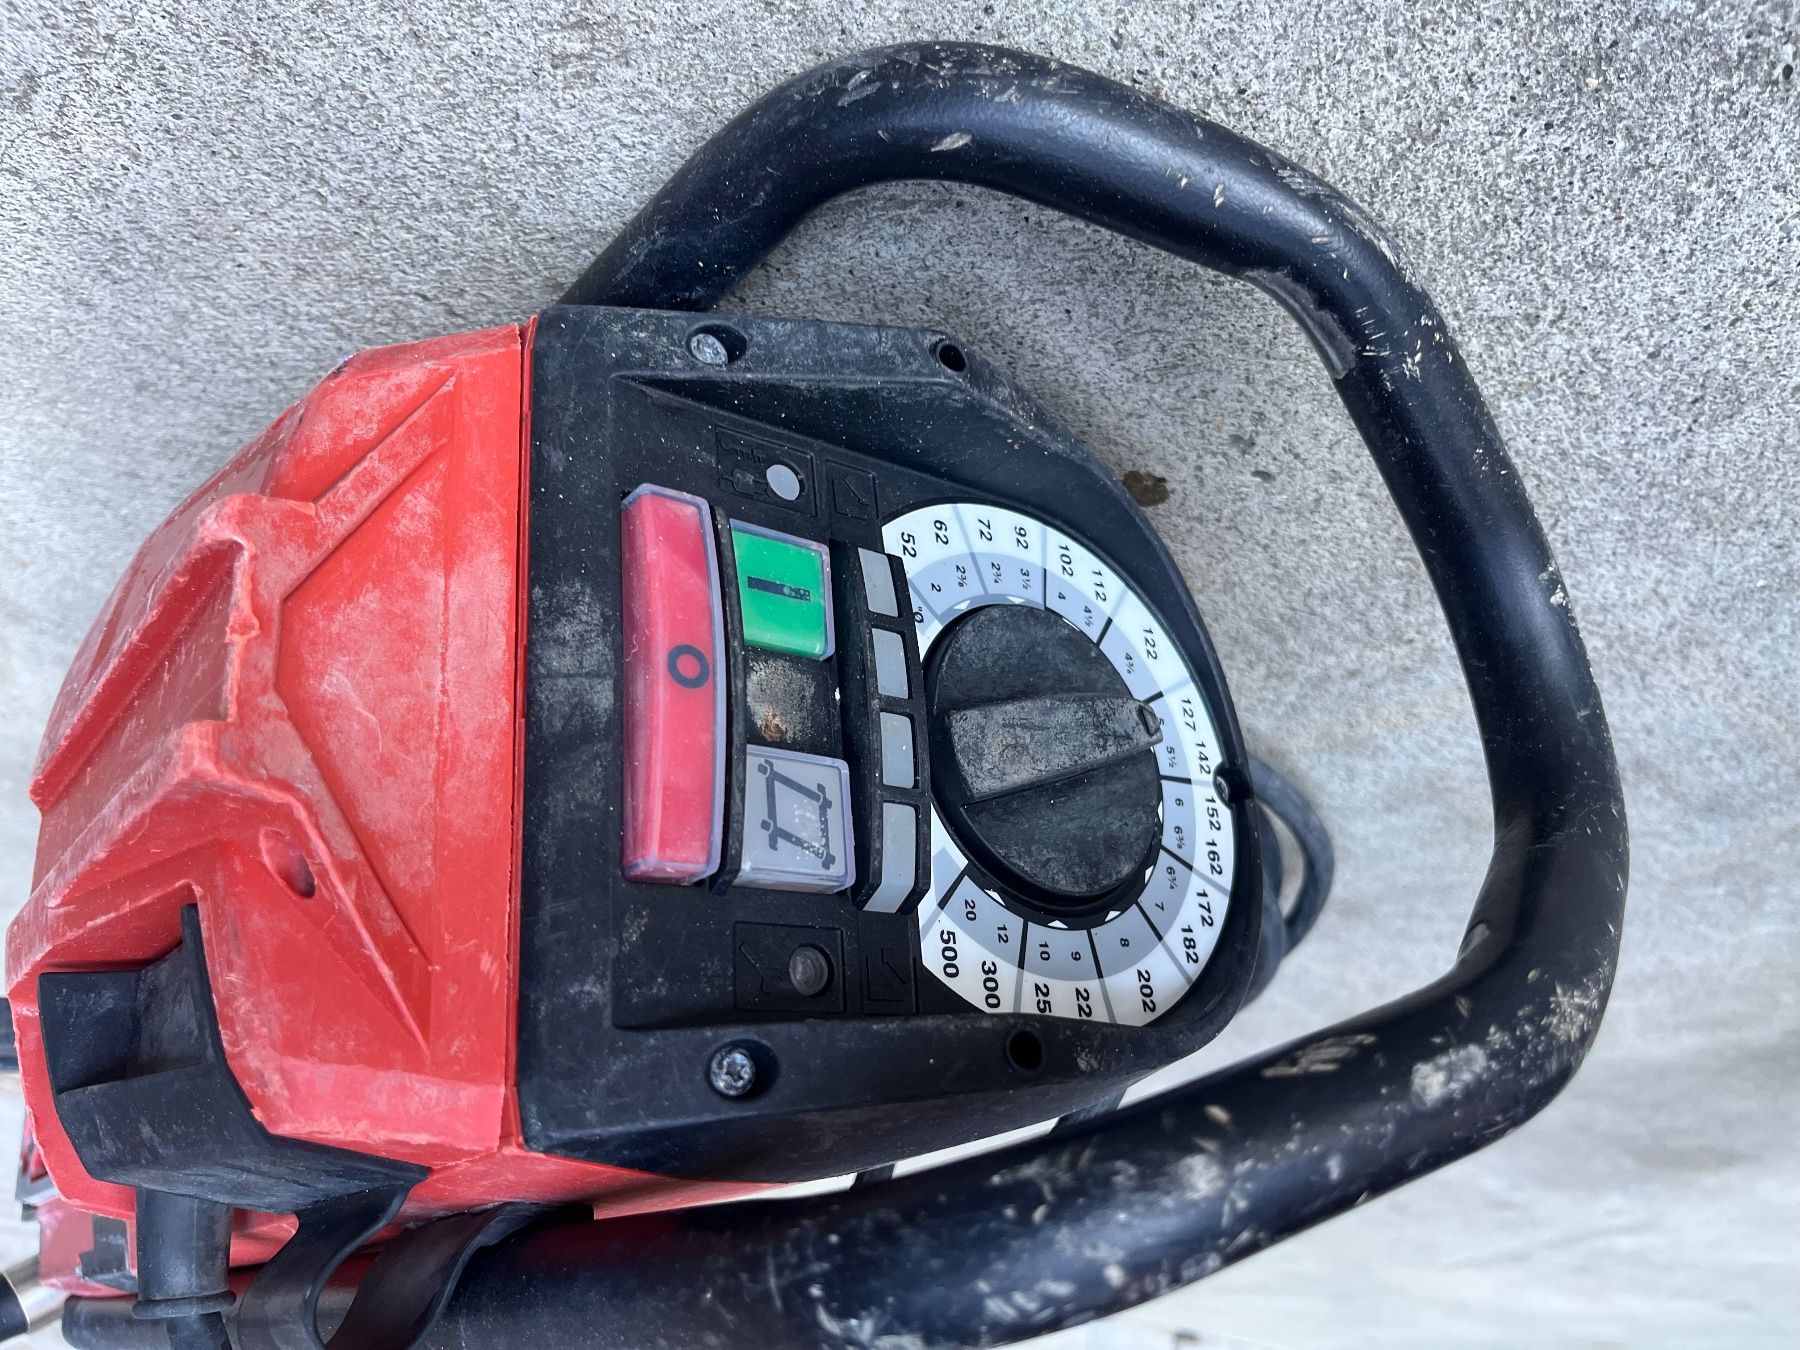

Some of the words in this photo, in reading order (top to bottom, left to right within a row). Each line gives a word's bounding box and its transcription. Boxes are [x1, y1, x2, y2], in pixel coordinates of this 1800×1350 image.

[900, 531, 917, 558] 52
[933, 520, 949, 546] 62
[978, 518, 993, 542] 72
[1014, 525, 1029, 550] 92
[1058, 544, 1074, 577] 102
[930, 582, 942, 593] 2
[1057, 591, 1066, 600] 4
[1092, 569, 1107, 602] 112
[1143, 627, 1158, 661] 122
[1181, 696, 1196, 732] 127
[1195, 741, 1212, 775] 142
[1174, 798, 1184, 807] 6
[1204, 796, 1221, 831] 152
[1205, 838, 1223, 875] 162
[964, 899, 977, 922] 20
[1154, 902, 1165, 911] 7
[1196, 889, 1214, 928] 172
[997, 924, 1009, 944] 12
[1119, 937, 1130, 947] 8
[1181, 925, 1199, 964] 182
[939, 929, 960, 978] 500
[1038, 941, 1050, 961] 10
[1071, 951, 1081, 961] 9
[981, 960, 1001, 1009] 300
[1034, 982, 1052, 1014] 25
[1137, 968, 1157, 1013] 202
[1075, 987, 1092, 1018] 22
